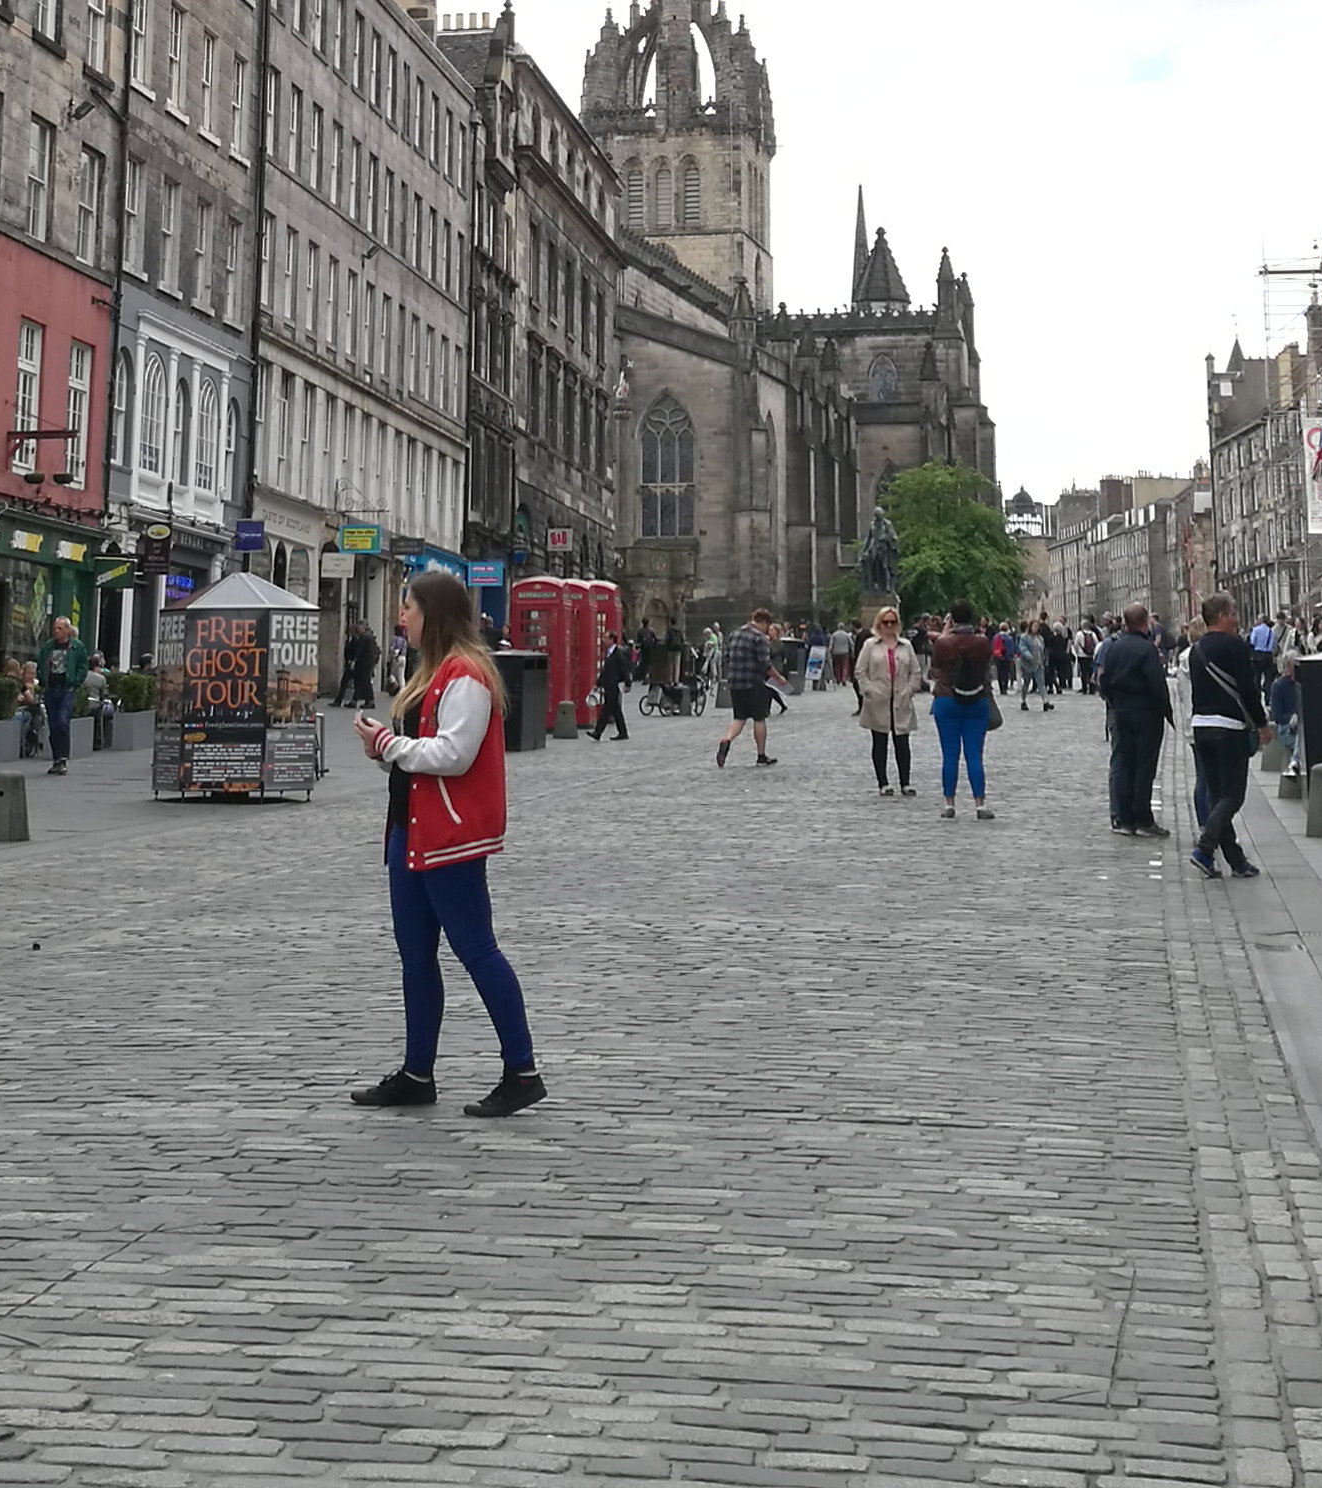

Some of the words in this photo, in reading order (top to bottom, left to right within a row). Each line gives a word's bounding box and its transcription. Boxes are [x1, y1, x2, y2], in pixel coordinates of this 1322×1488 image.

[159, 614, 185, 640] FREE
[195, 616, 257, 647] FREE
[271, 614, 320, 641] FREE
[159, 642, 184, 666] TOUR
[185, 648, 267, 678] GHOST
[270, 642, 318, 666] TOUR
[190, 679, 262, 709] TOUR
